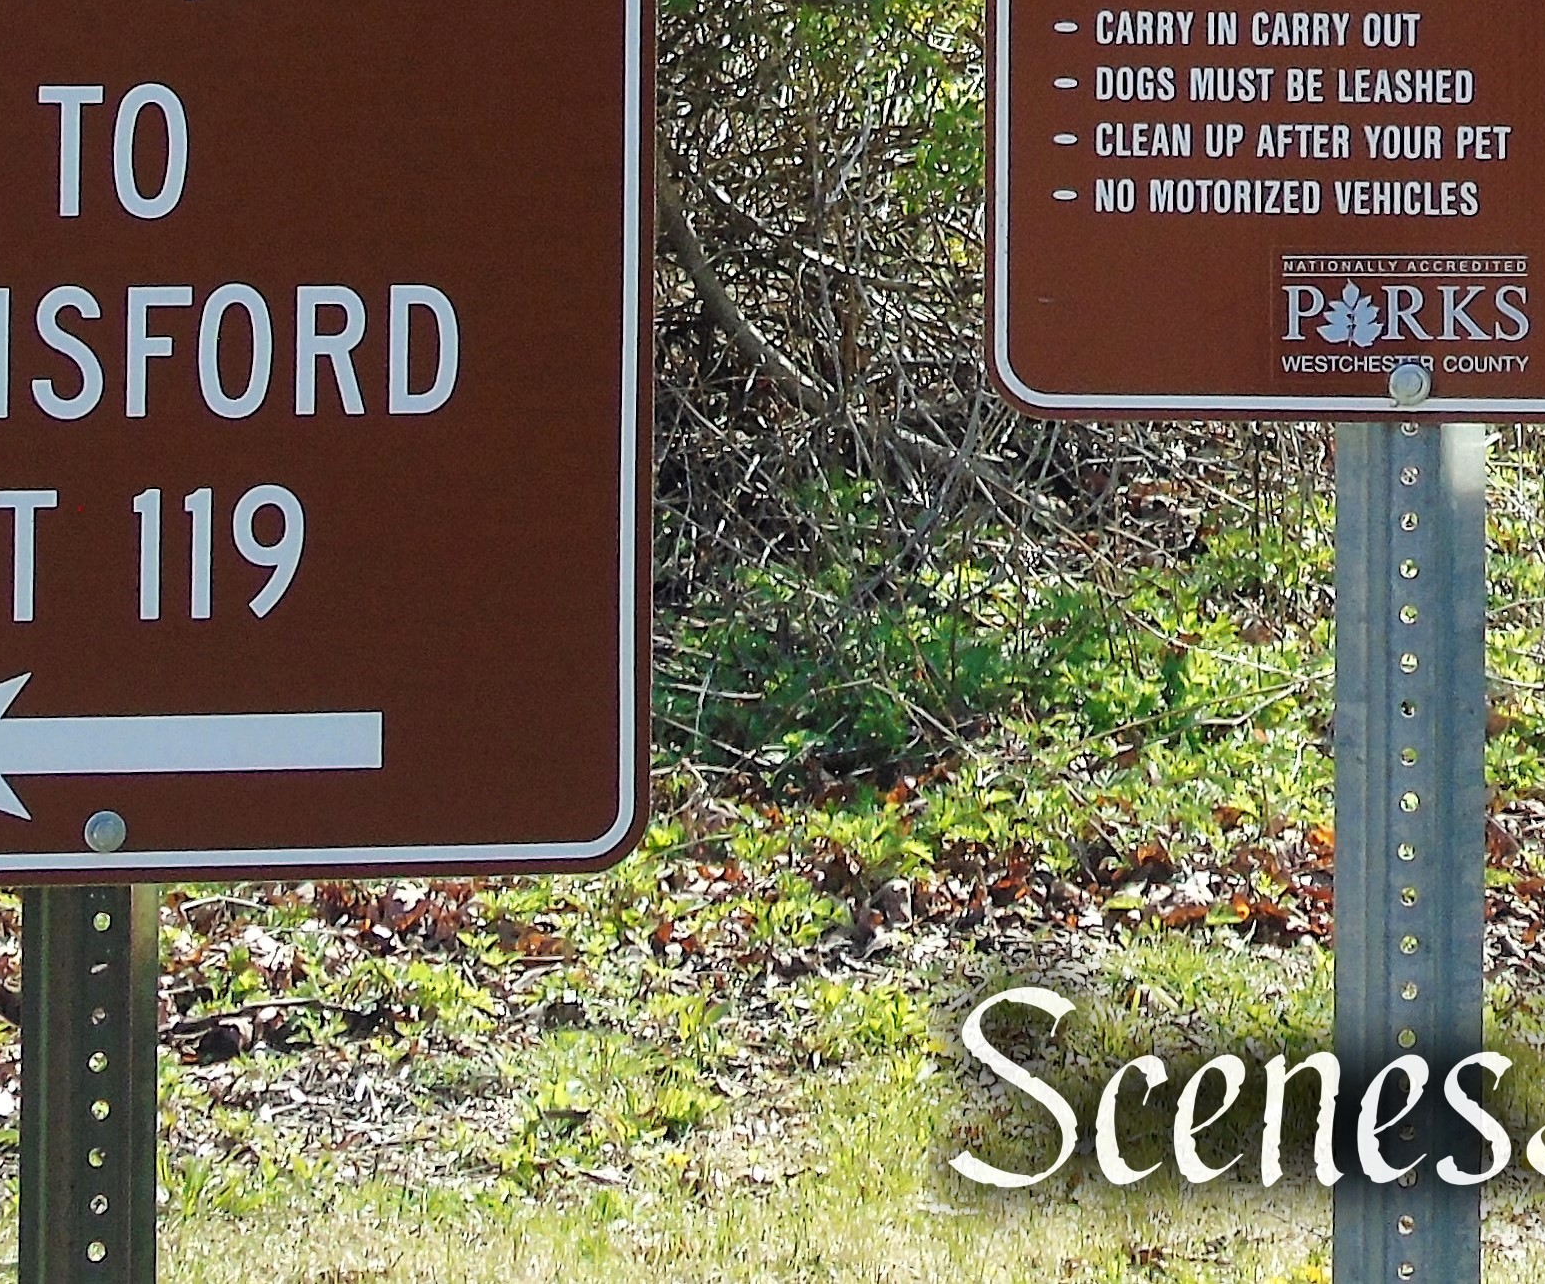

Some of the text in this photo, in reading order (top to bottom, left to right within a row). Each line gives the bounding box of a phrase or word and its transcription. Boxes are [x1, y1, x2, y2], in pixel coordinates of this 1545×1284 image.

[1096, 10, 1421, 47] CARRY IN CARRY OUT
[1096, 66, 1473, 104] DOGS MUST BE LEASHED
[38, 83, 188, 219] TO
[1095, 122, 1512, 160] CLEAN UP AFTER YOUR PET
[1095, 178, 1479, 216] NO MOTORIZED VEHICLES
[1283, 260, 1527, 273] NATIONALLY ACCREDITED
[1281, 283, 1529, 343] PRKS
[1442, 355, 1529, 373] COUNTY
[133, 484, 305, 620] 119
